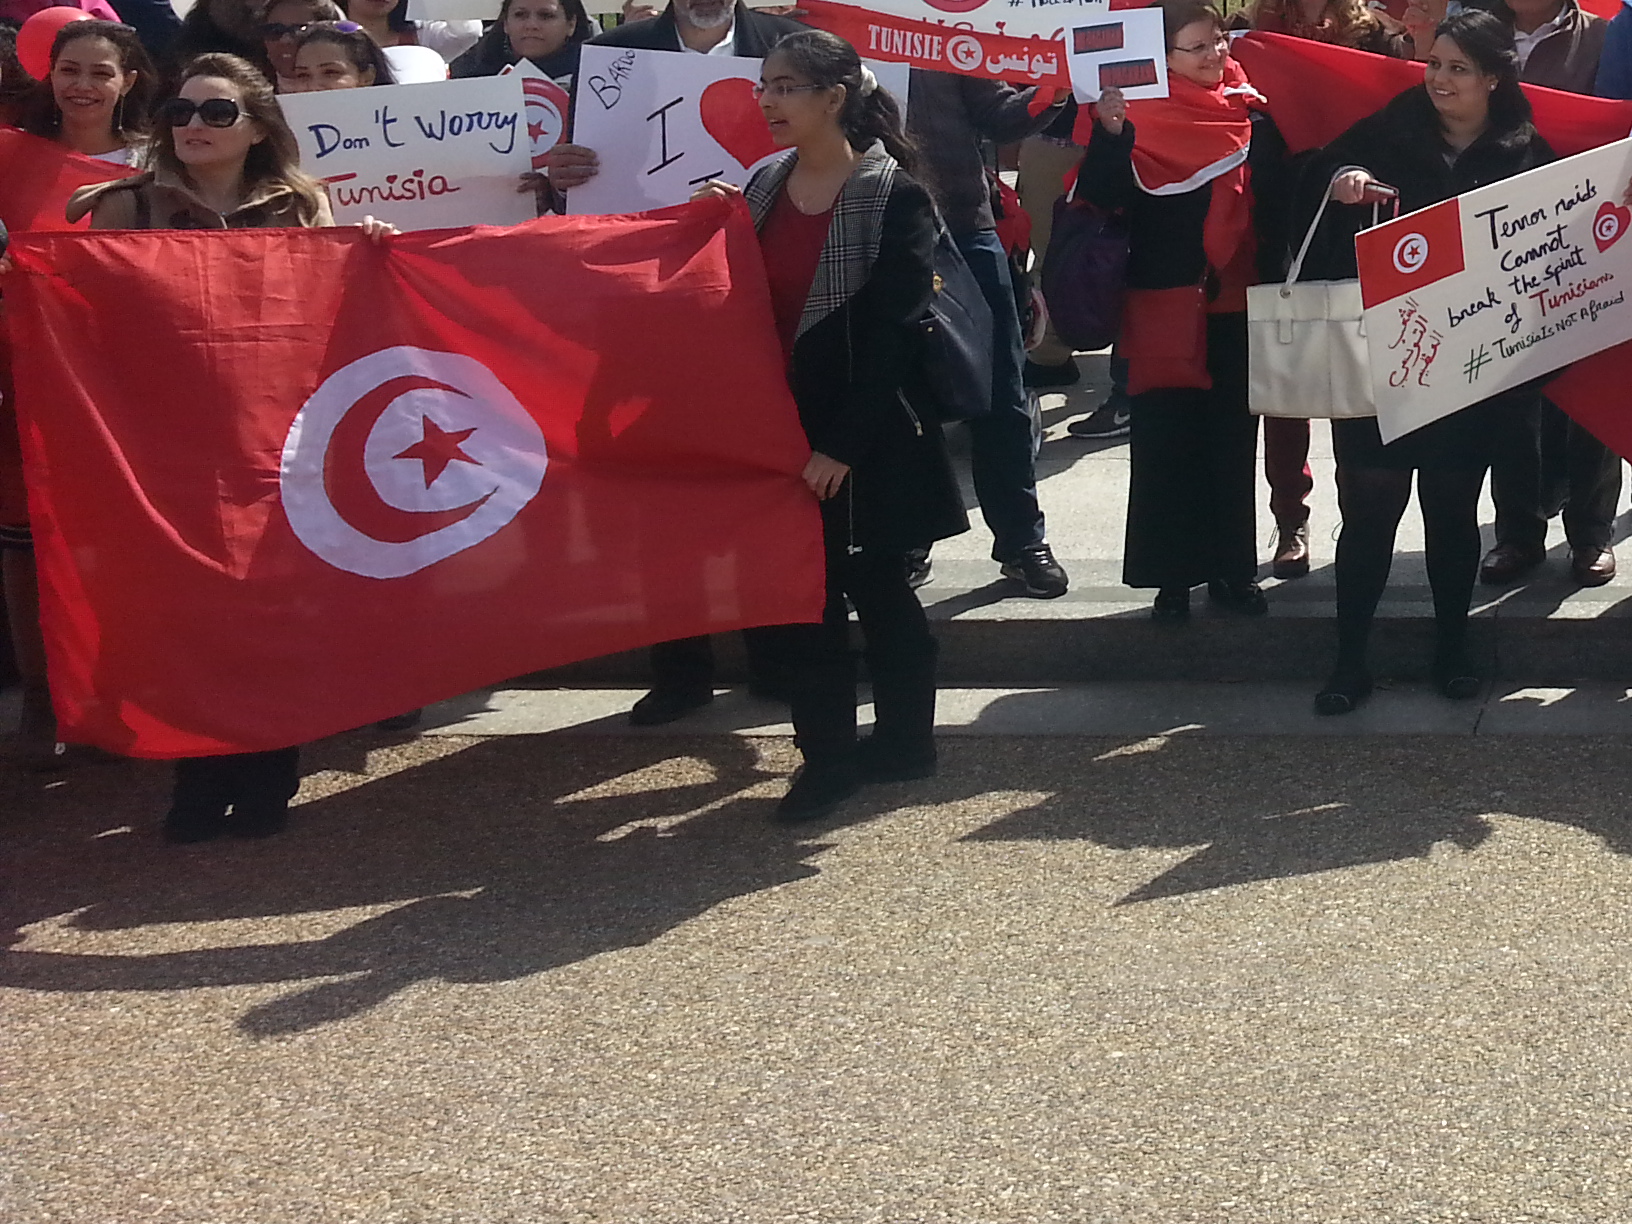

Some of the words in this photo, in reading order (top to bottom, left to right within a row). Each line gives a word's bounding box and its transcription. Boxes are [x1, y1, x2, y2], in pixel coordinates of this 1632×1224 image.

[868, 24, 942, 61] TUNISIE
[985, 46, 1058, 79] تونس
[588, 49, 636, 110] BARDO
[308, 105, 405, 159] Don't
[646, 97, 685, 175] I
[1474, 204, 1547, 250] Terror
[1555, 178, 1597, 216] raids
[1448, 287, 1501, 327] break
[1508, 275, 1541, 295] the
[1543, 246, 1586, 286] spirit
[1504, 302, 1522, 334] of
[1528, 273, 1614, 317] Tunisians
